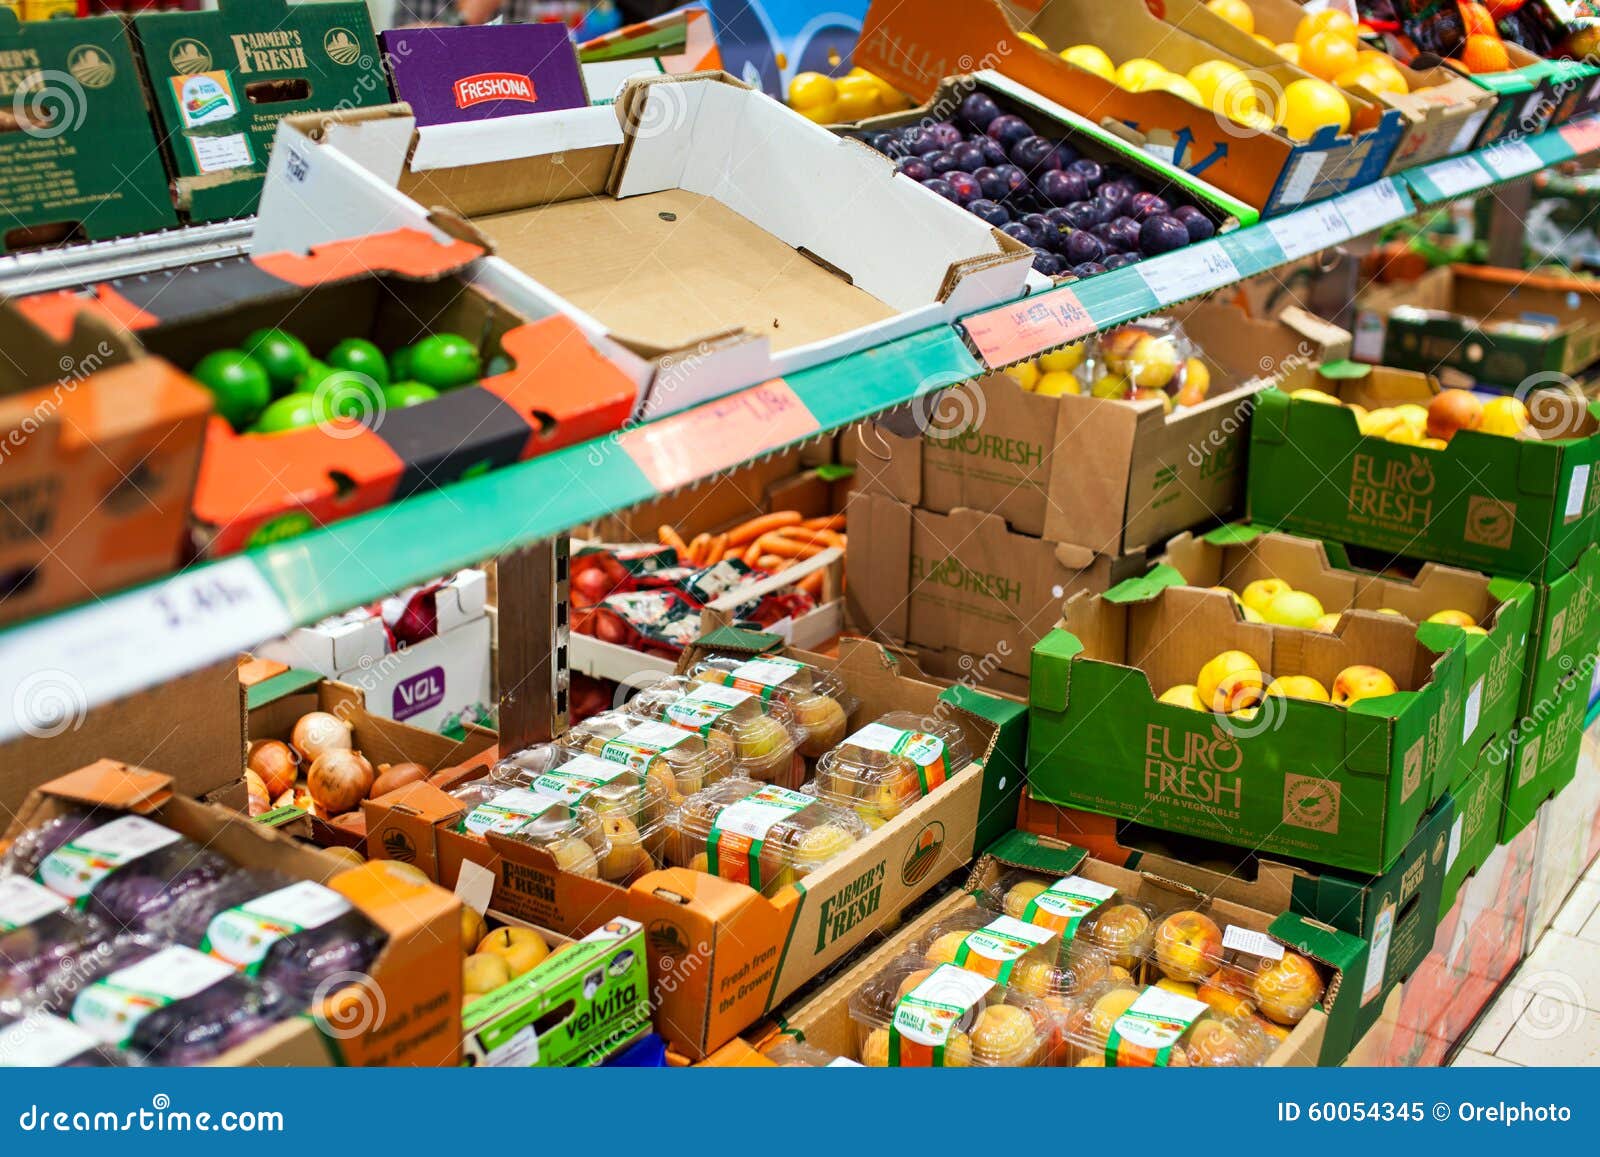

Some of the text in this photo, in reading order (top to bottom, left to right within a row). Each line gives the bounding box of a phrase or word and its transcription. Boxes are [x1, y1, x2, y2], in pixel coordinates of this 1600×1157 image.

[230, 30, 301, 62] FARMER'S
[230, 48, 307, 73] FRESH
[867, 26, 957, 84] ALLIA
[459, 78, 531, 102] FRESHONA
[1352, 453, 1435, 496] EURO
[1348, 486, 1433, 526] FRESH
[398, 675, 440, 706] VOL
[1146, 723, 1243, 773] EURO
[1144, 758, 1242, 808] FRESH
[1144, 791, 1171, 804] FRUIT
[1181, 799, 1240, 820] VEGETABLES
[815, 883, 883, 955] FRESH
[818, 858, 887, 938] FARMER'S
[719, 966, 775, 1014] the Grower
[720, 945, 777, 993] Fresh from
[566, 983, 636, 1041] velvita
